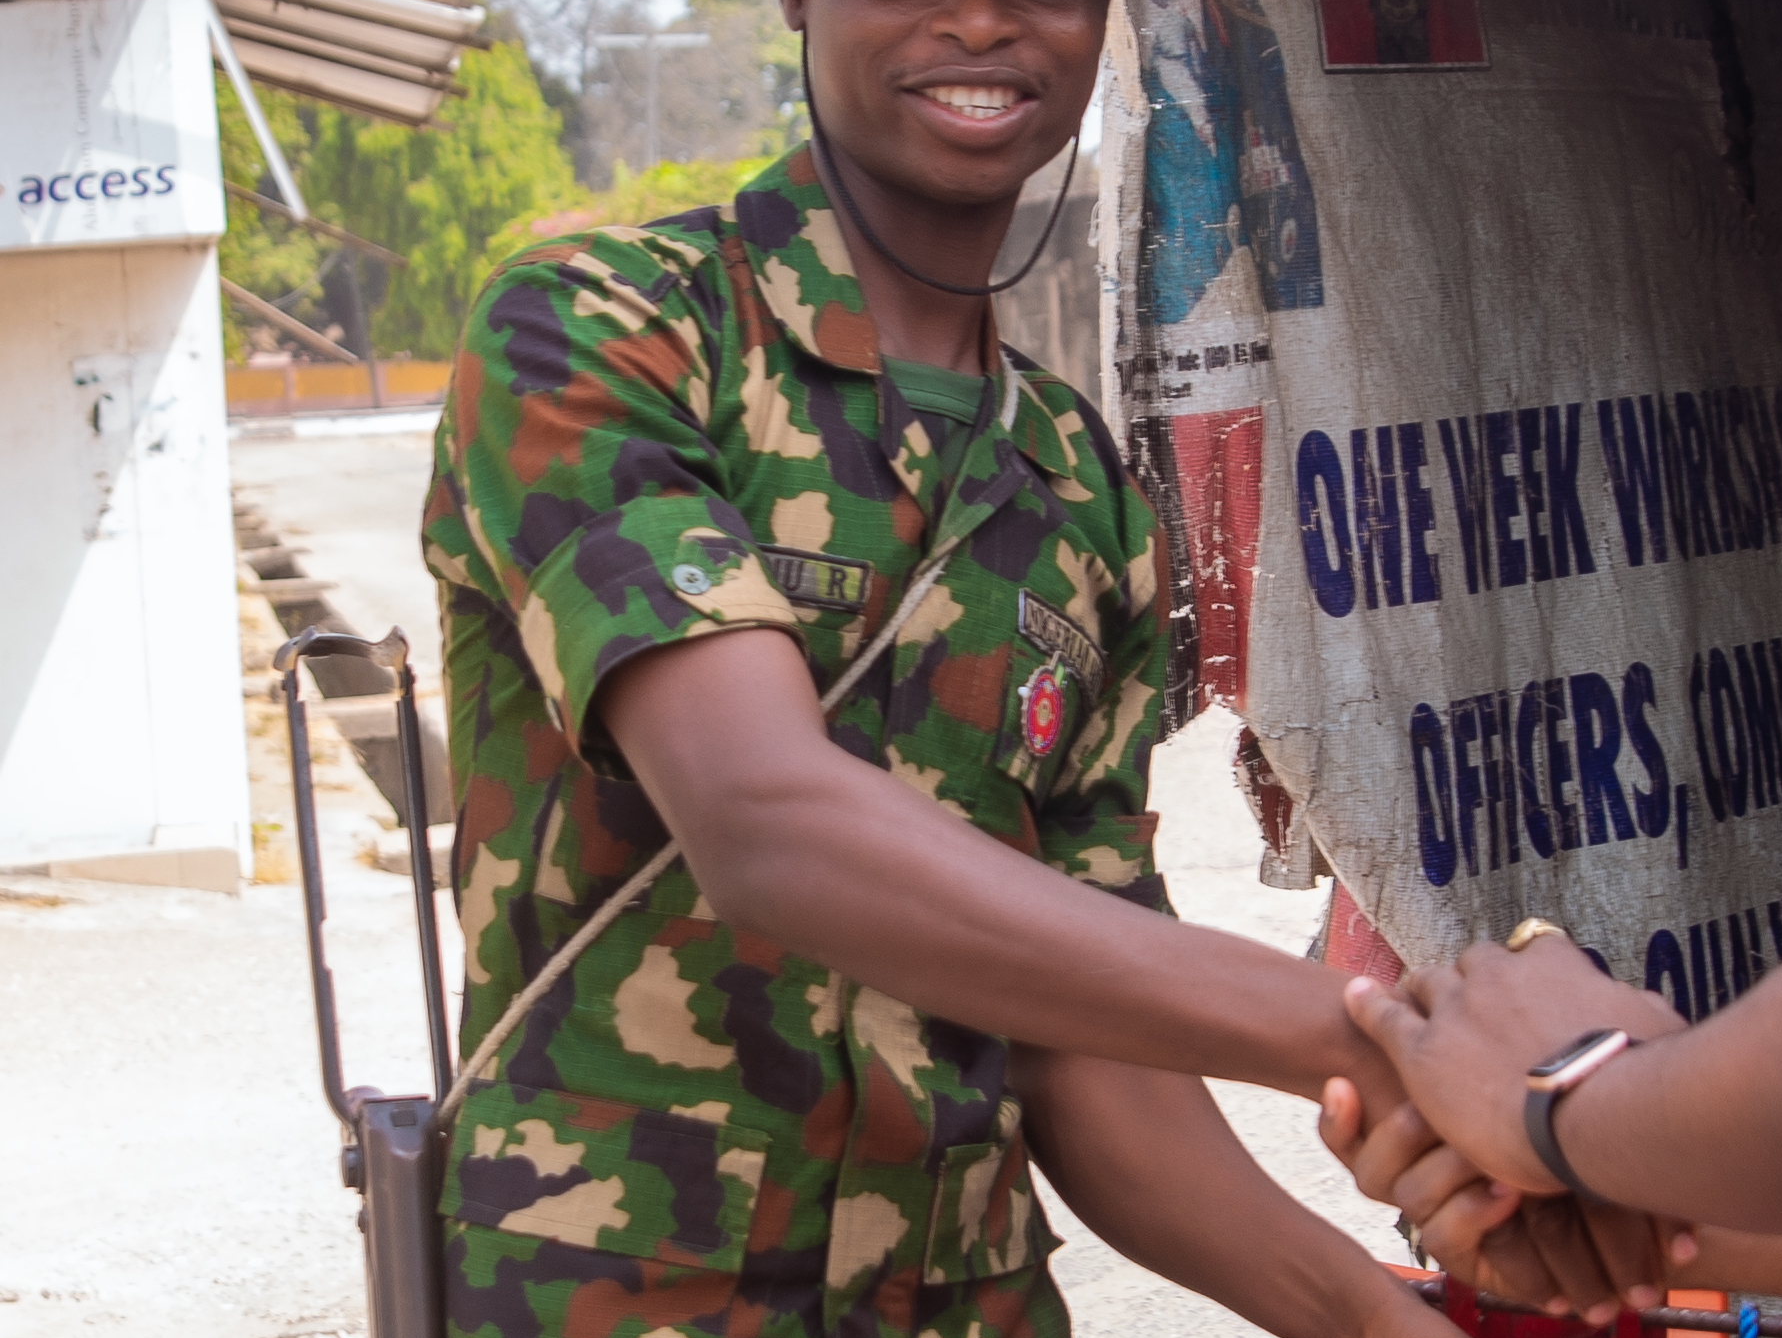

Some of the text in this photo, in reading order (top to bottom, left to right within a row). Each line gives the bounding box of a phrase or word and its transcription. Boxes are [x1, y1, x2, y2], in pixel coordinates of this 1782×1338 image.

[18, 164, 176, 206] access
[1295, 421, 1443, 618] ONE
[1437, 402, 1597, 596] WEEK
[825, 565, 847, 601] R
[1410, 662, 1690, 887] OFFICERS,
